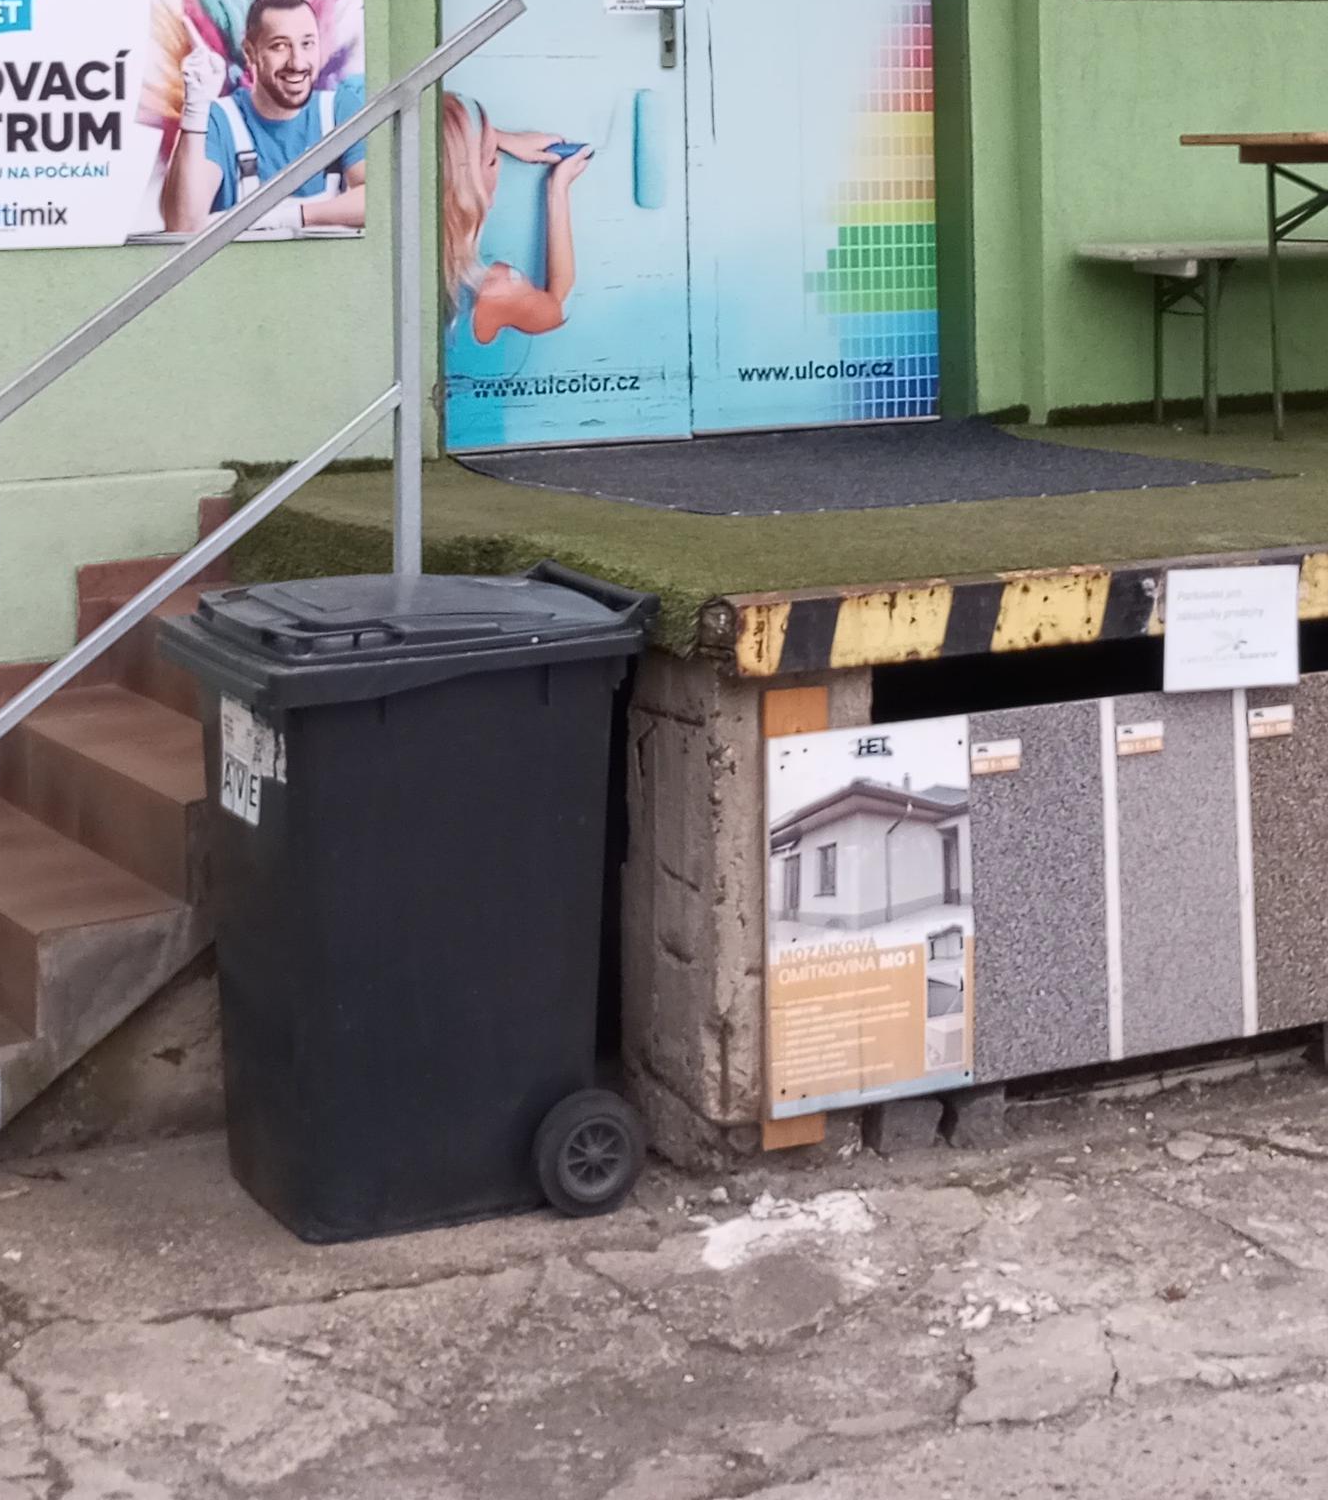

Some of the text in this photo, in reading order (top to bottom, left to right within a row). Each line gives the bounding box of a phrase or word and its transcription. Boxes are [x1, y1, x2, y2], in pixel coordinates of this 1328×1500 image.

[7, 167, 30, 180] NA
[34, 161, 110, 179] POČKÁNÍ
[738, 360, 894, 383] www.ulcolor.cz
[473, 374, 640, 398] www.ulcolor.cz
[858, 737, 888, 756] HET
[224, 760, 258, 808] AVE
[778, 949, 916, 985] OMÍTKOVINA MO1
